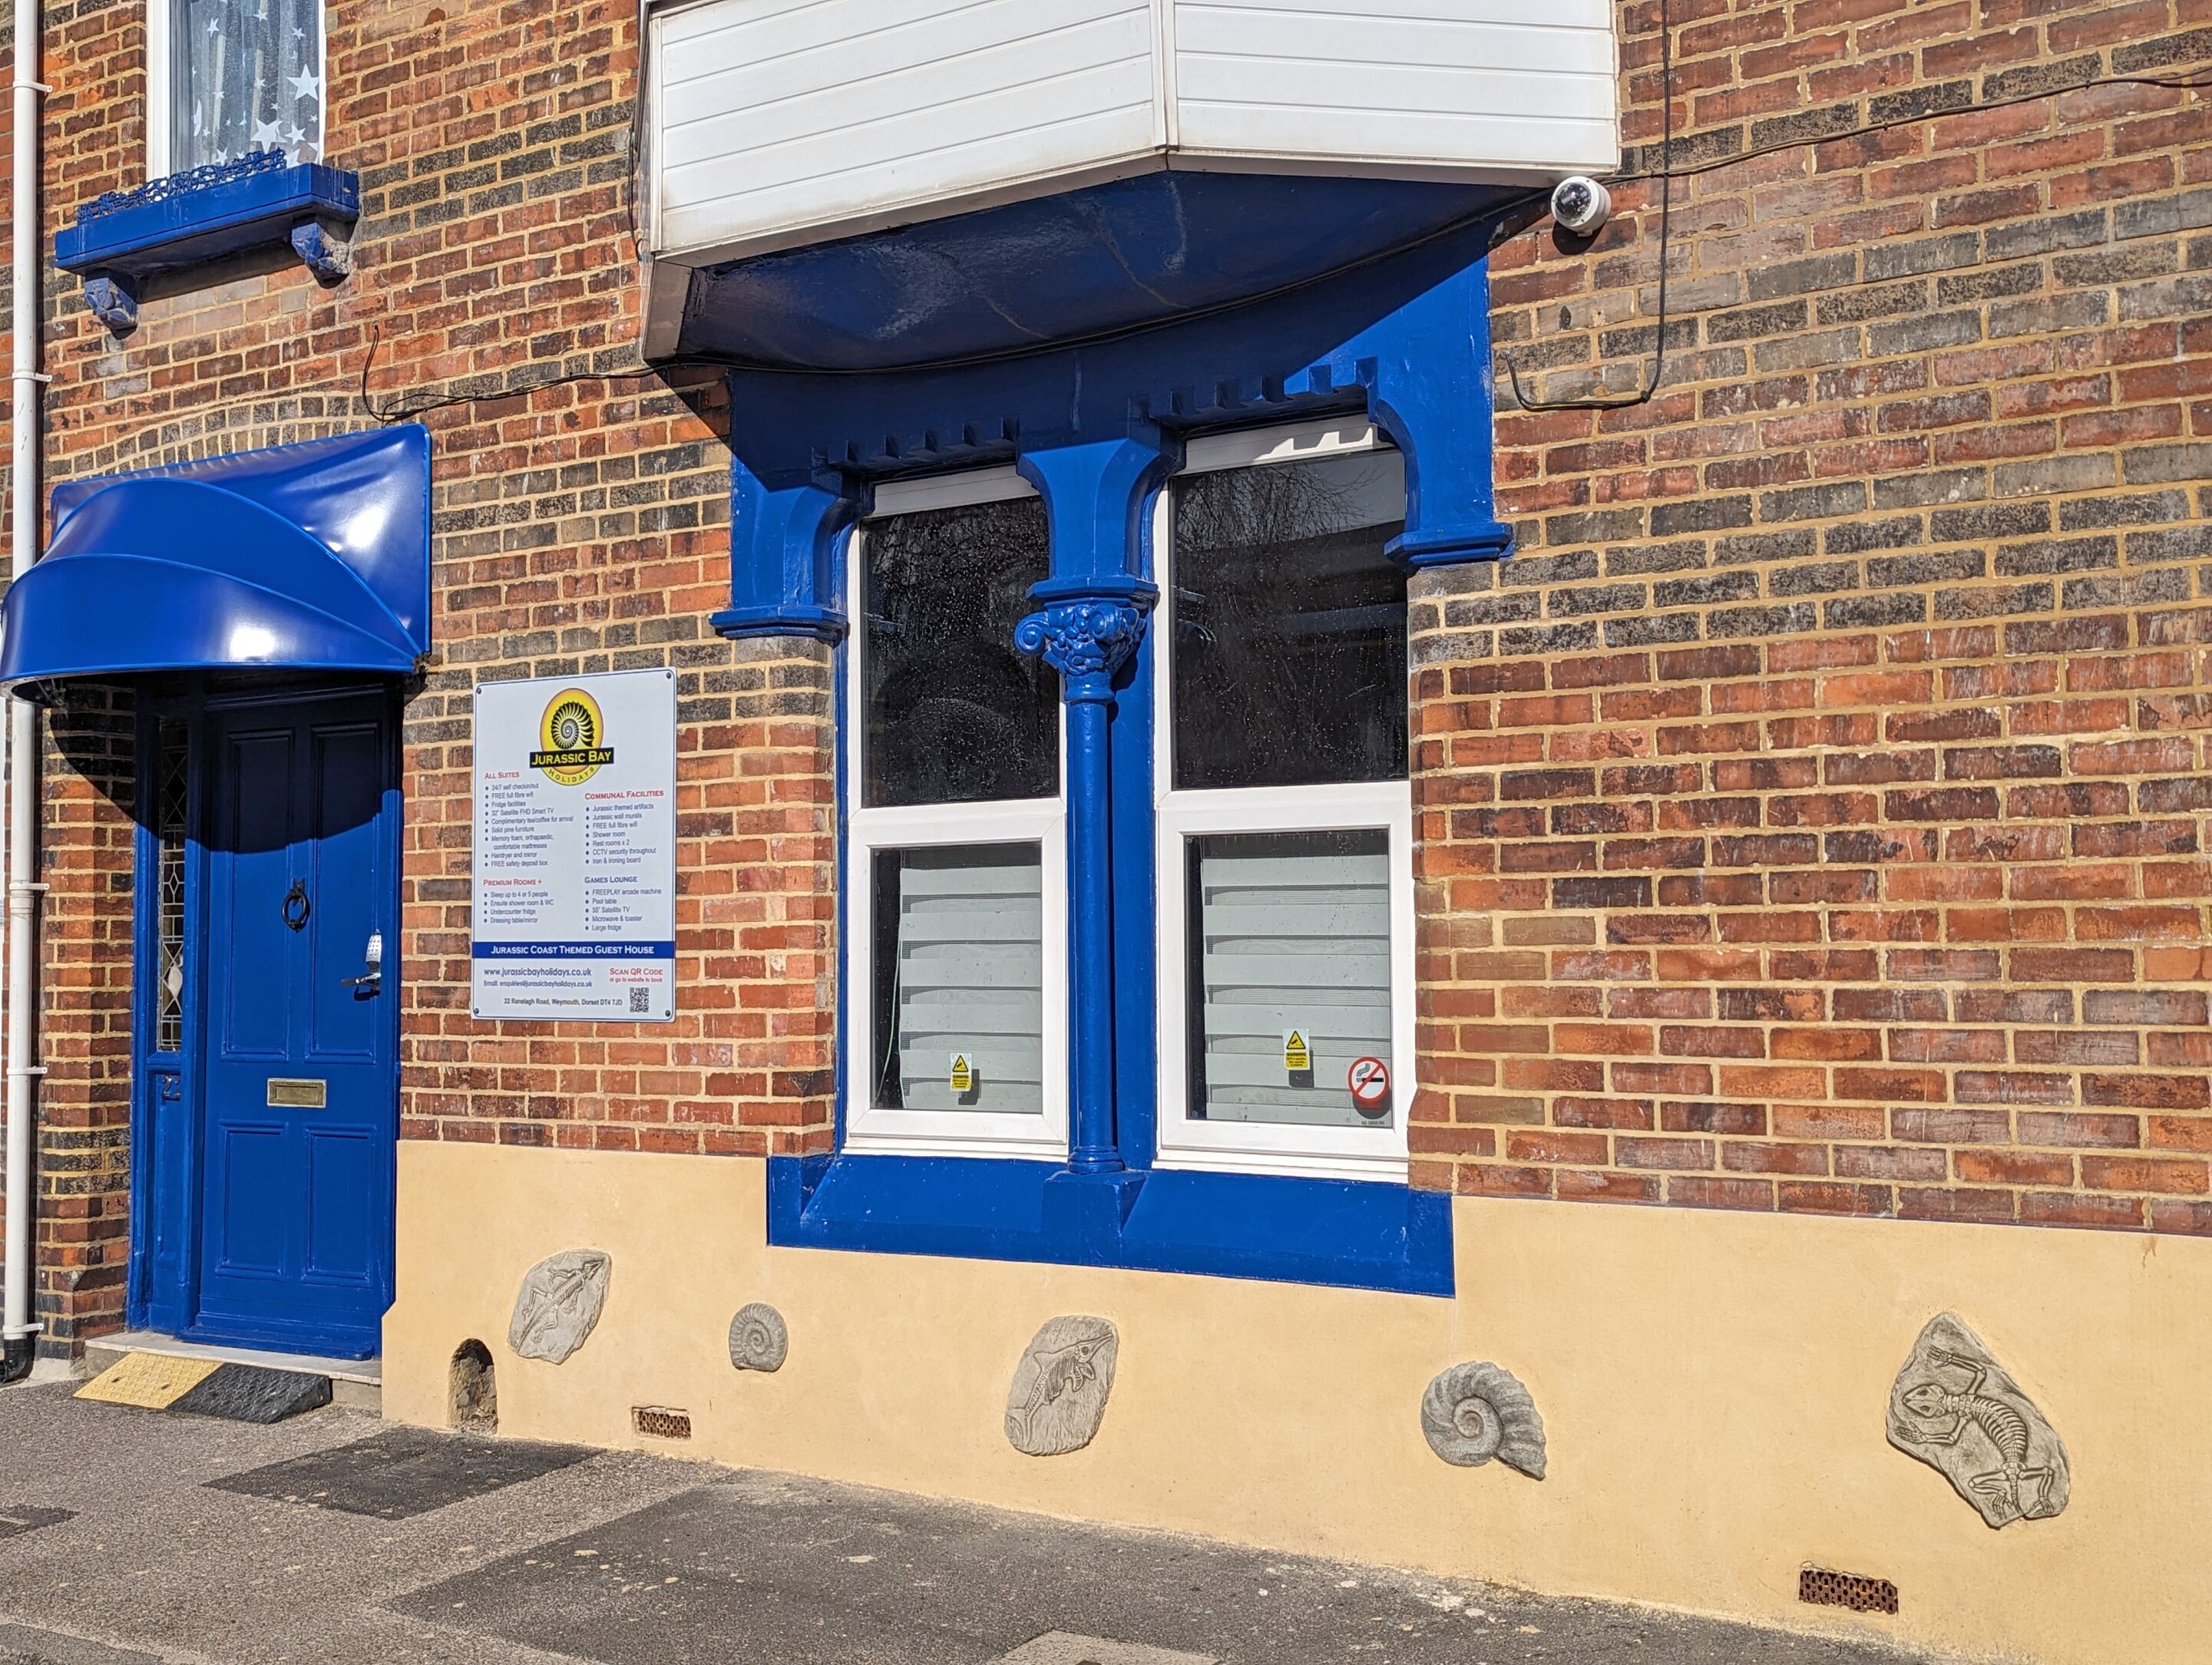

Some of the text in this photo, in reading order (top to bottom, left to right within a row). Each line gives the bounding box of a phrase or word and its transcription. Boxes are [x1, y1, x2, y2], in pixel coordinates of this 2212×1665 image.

[532, 751, 611, 765] JURASSIC BAY
[549, 767, 594, 782] HOLIDAYS
[595, 945, 623, 953] GUEST
[484, 968, 591, 977] www.jurassicbayholidays.co.uk
